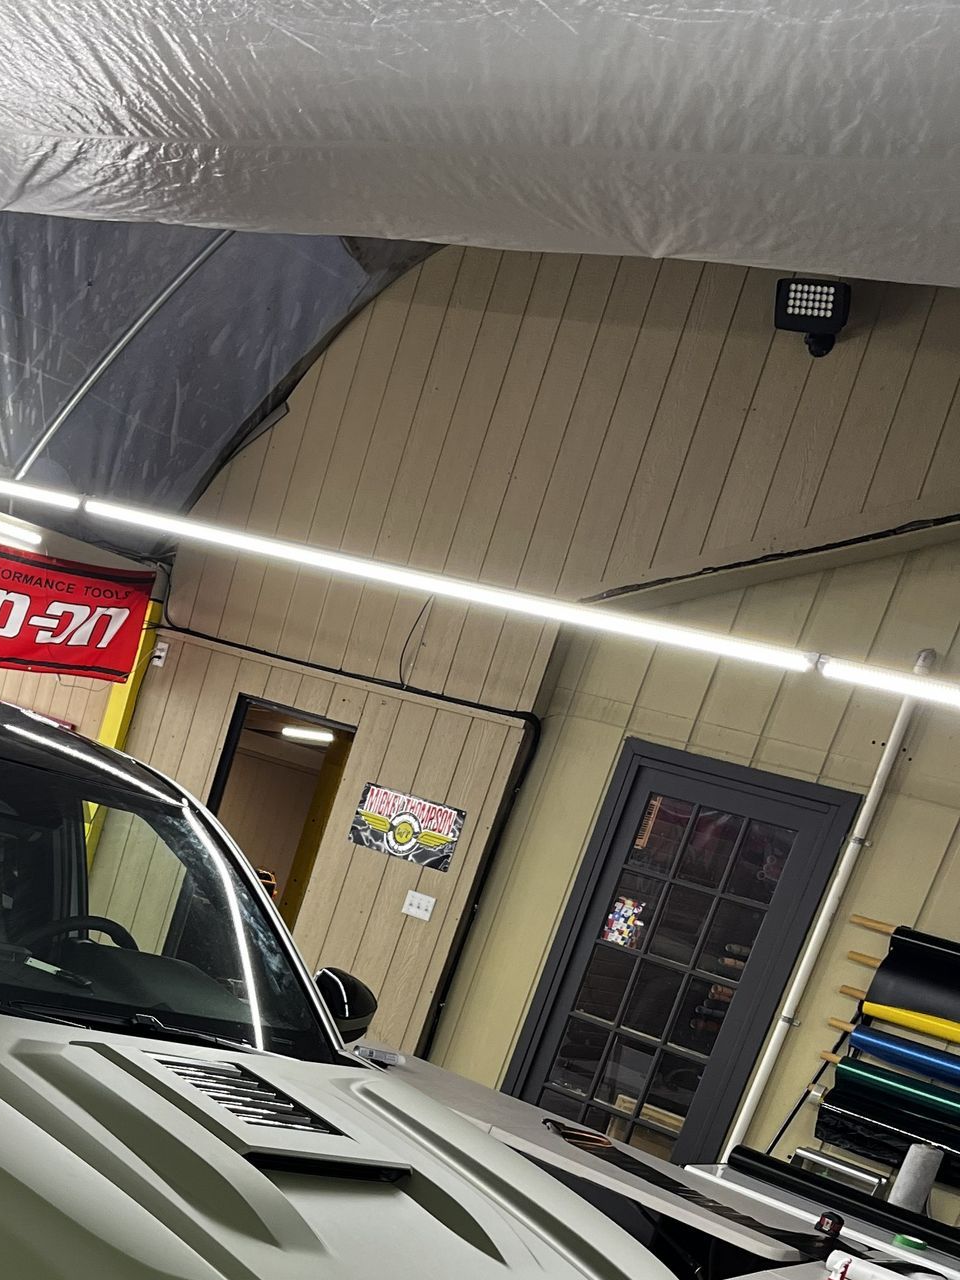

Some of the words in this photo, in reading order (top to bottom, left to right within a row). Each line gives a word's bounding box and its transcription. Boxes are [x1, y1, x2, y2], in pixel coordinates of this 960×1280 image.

[83, 585, 132, 601] TOOLS
[363, 785, 401, 817] MICKEY
[401, 796, 458, 837] THOMPSON
